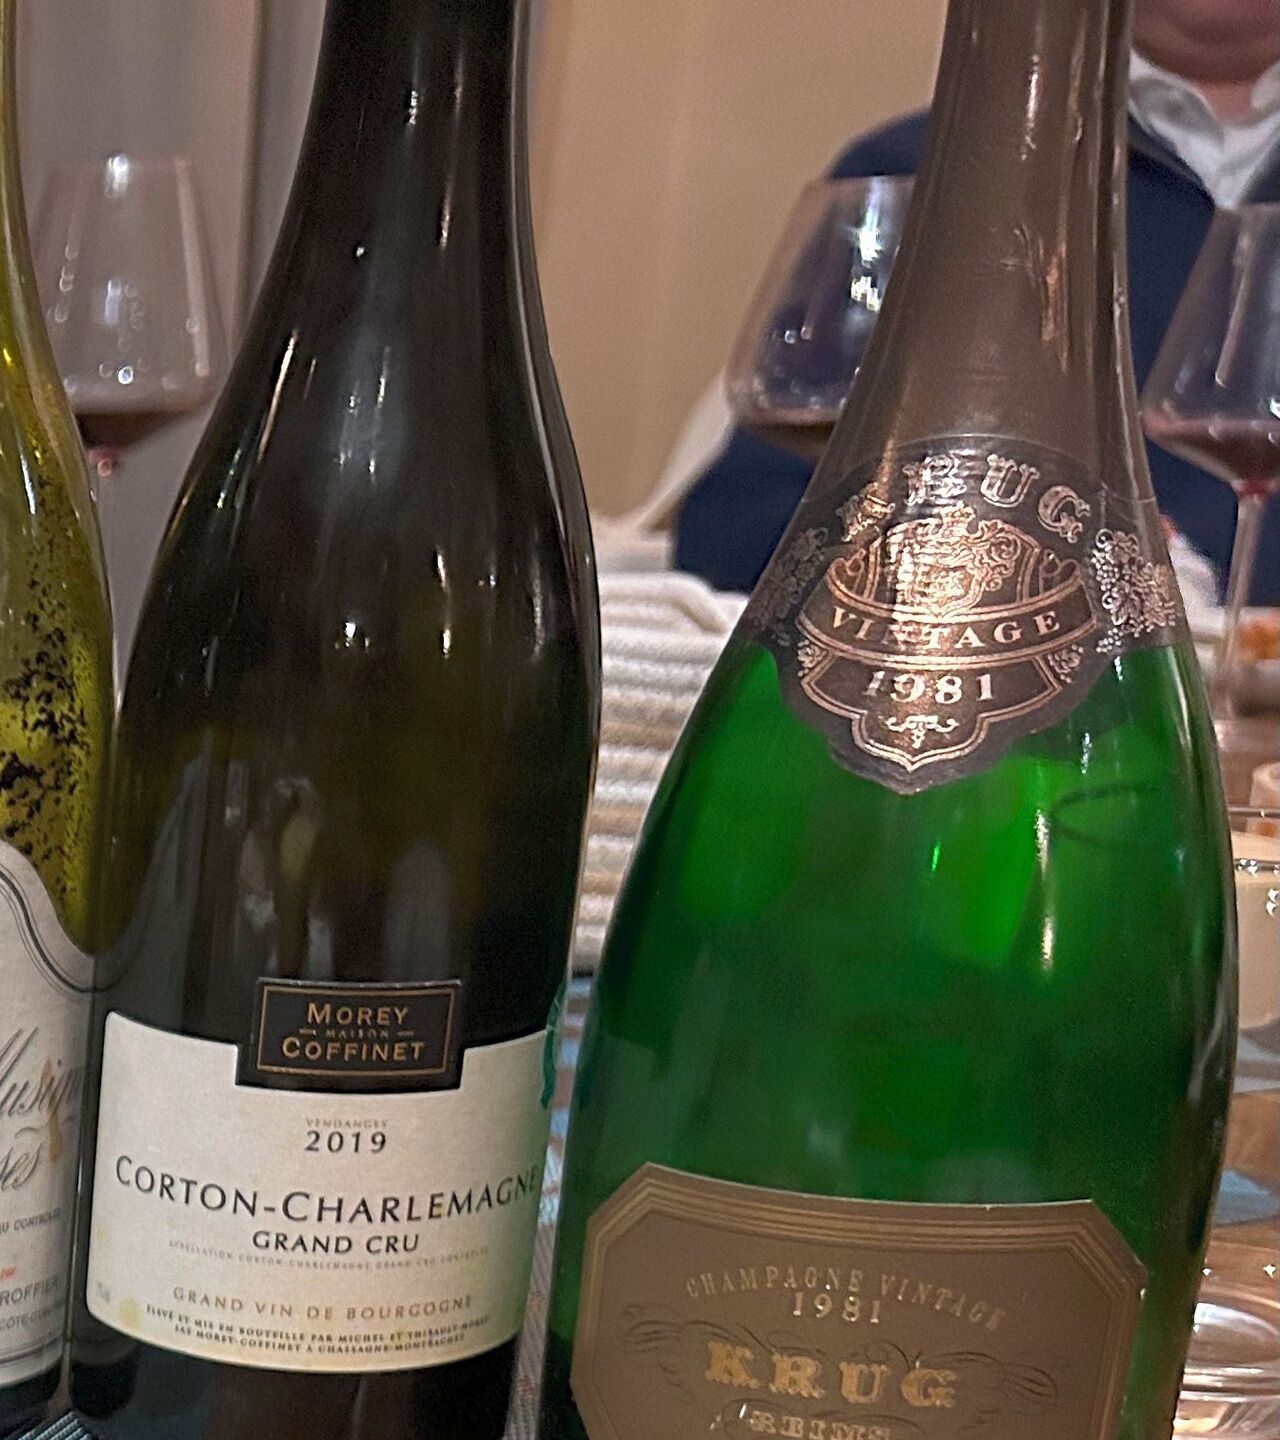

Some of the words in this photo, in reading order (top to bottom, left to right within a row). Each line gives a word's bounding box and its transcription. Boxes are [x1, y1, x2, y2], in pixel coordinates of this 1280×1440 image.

[832, 606, 1060, 650] VINTAGE
[862, 671, 995, 705] 1981
[306, 1002, 409, 1027] MOREY
[282, 1036, 425, 1062] COFFINET
[304, 1130, 387, 1154] 2019
[252, 1230, 353, 1256] GRAND
[365, 1233, 420, 1256] CRU
[173, 1286, 243, 1312] GRAND
[255, 1302, 293, 1319] VIN
[307, 1305, 333, 1321] DE
[346, 1294, 473, 1322] BOURGOGNE
[685, 1264, 865, 1301] CHAMPAGNE
[880, 1273, 1008, 1332] VINTAGE
[791, 1290, 881, 1324] 1981
[703, 1340, 961, 1409] KRUG
